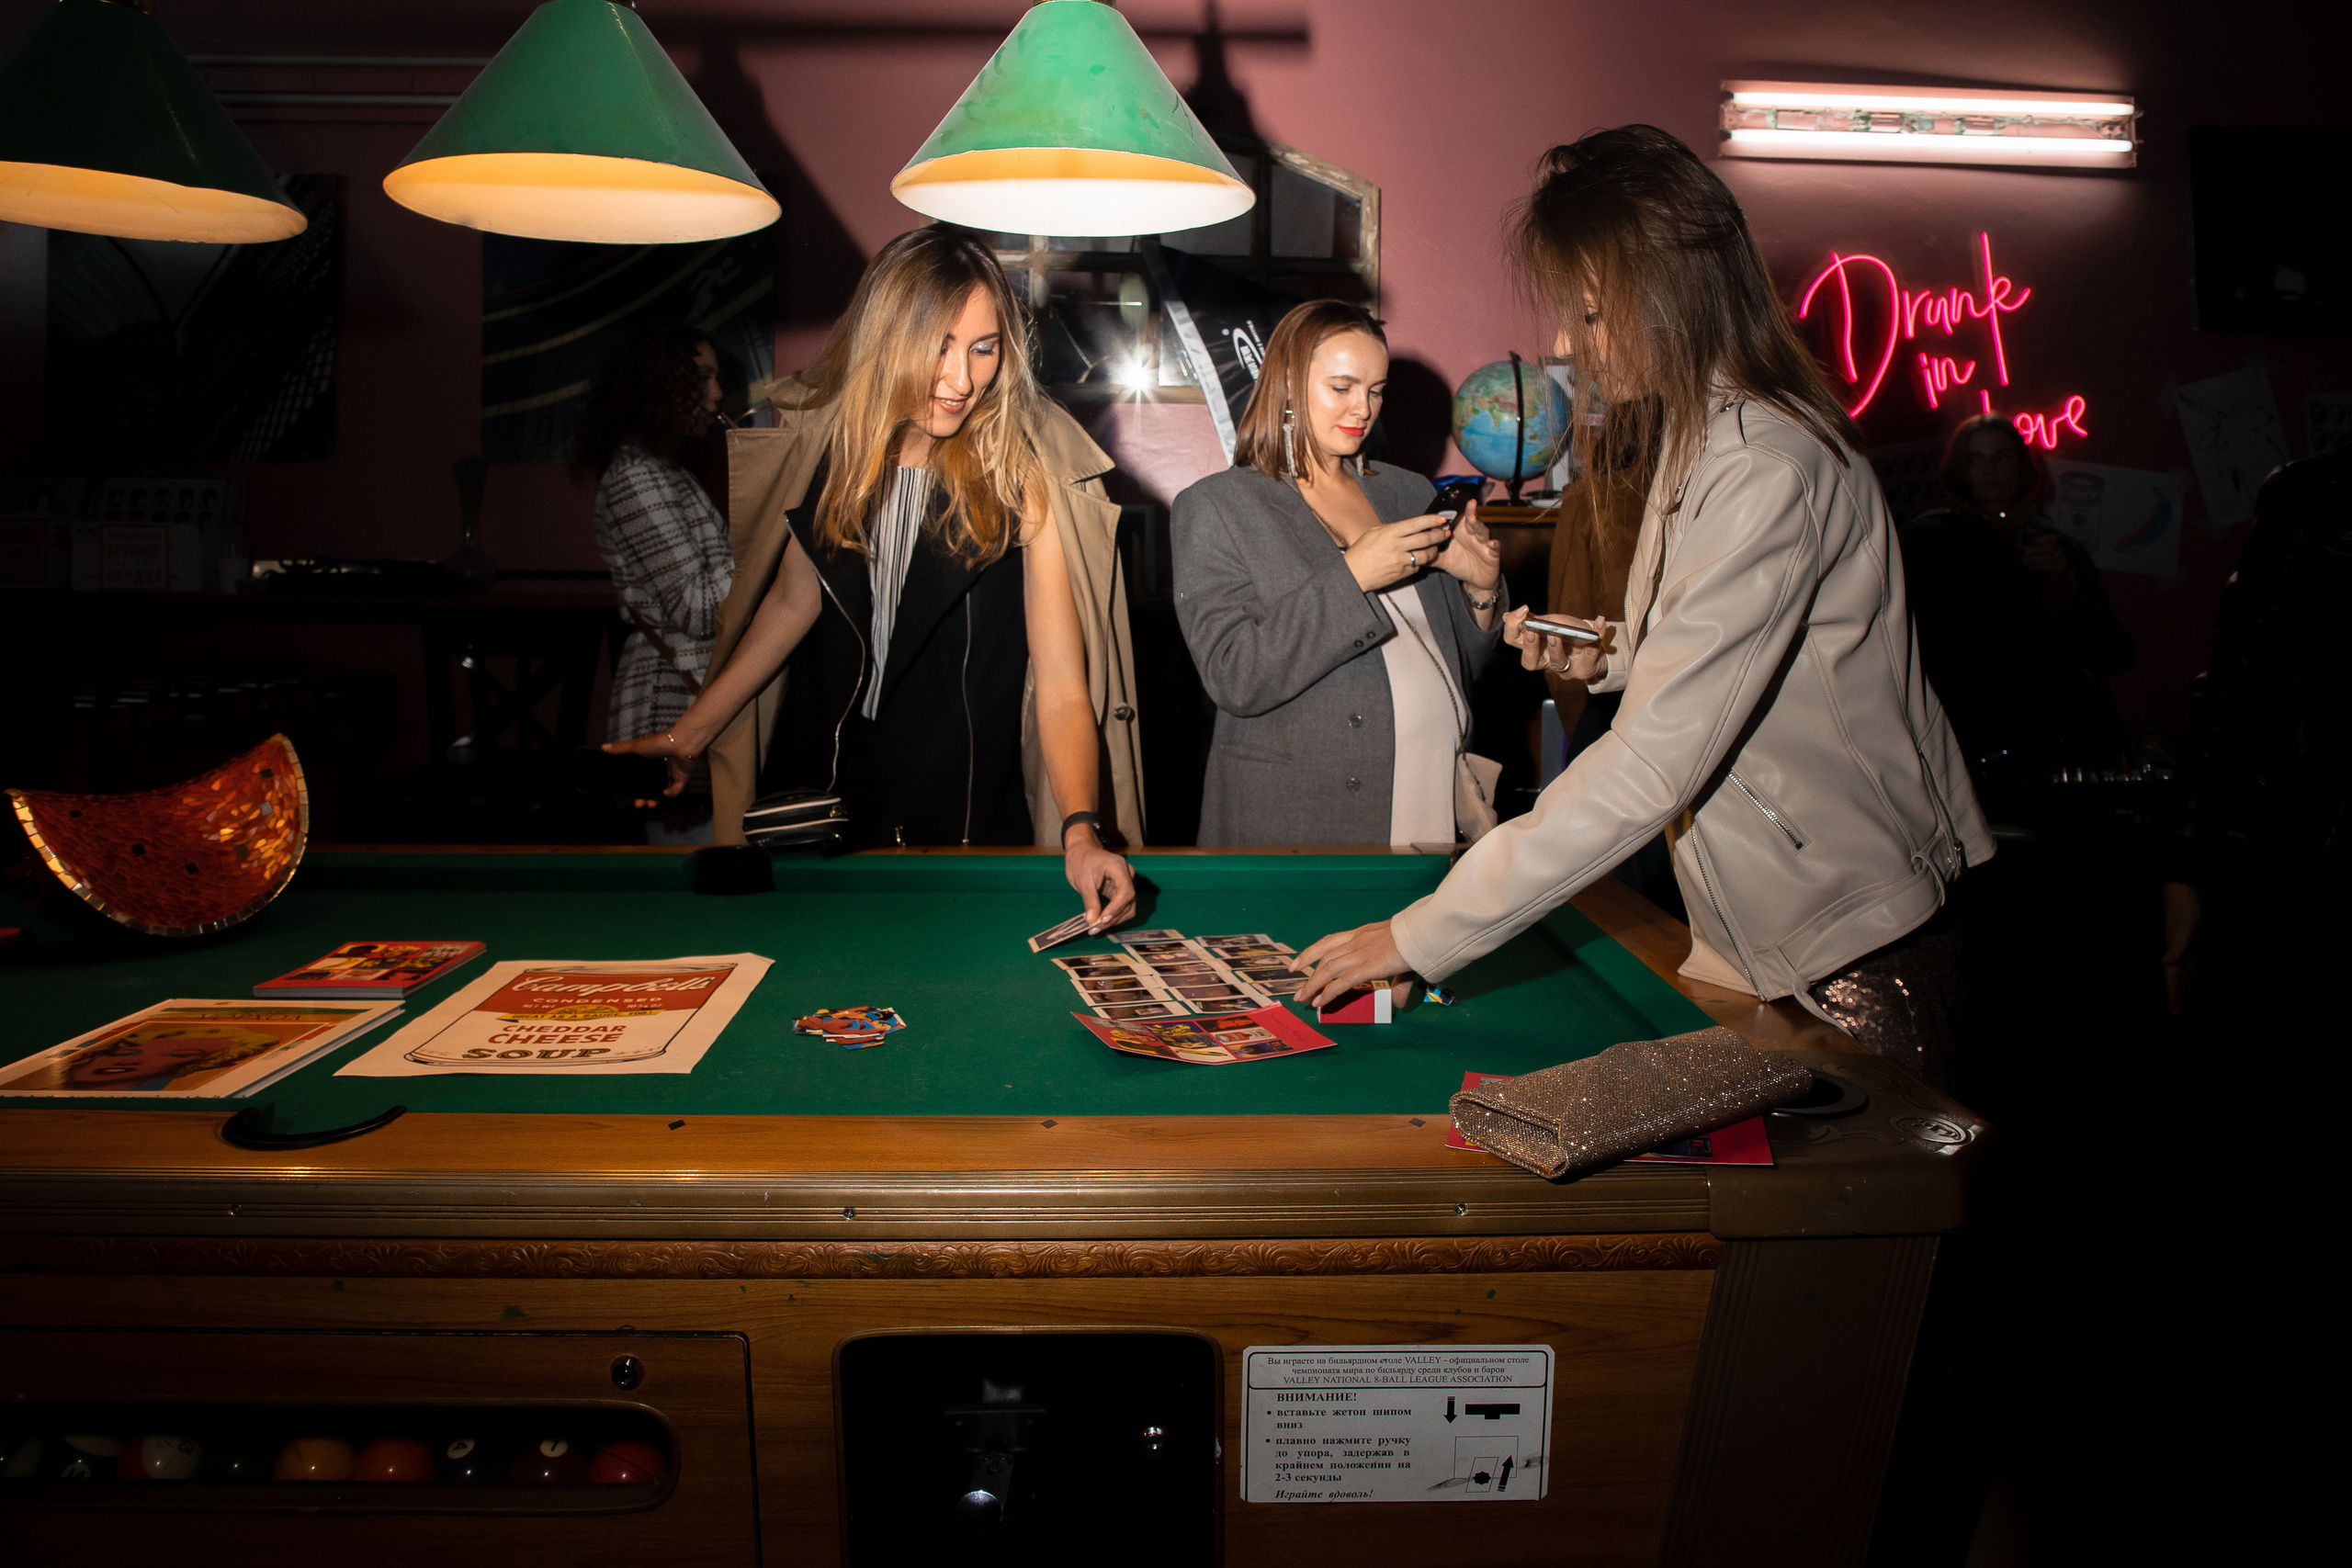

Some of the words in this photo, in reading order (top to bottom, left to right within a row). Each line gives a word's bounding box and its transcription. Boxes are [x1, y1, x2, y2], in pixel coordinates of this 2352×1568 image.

[1799, 231, 2031, 418] Drunk
[1920, 353, 1975, 408] in
[488, 1032, 624, 1044] CHEESE
[462, 1048, 611, 1059] SOUP
[1328, 1357, 1377, 1365] бильярдном
[1449, 1357, 1504, 1365] официальном
[1377, 1367, 1416, 1375] бильярду
[1417, 1367, 1441, 1375] среди
[1442, 1366, 1471, 1374] клубов
[1481, 1366, 1504, 1375] баров
[1322, 1375, 1371, 1383] NATIONAL
[1409, 1374, 1447, 1382] LEAGUE
[1450, 1374, 1512, 1382] ASSOCIATION
[1276, 1393, 1356, 1402] ВНИМАНИЕ!
[550, 1440, 560, 1452] 7
[1377, 1438, 1410, 1446] ручку
[1296, 1450, 1332, 1459] упора,
[1341, 1450, 1394, 1459] задержав
[1275, 1461, 1323, 1471] крайнем
[1274, 1472, 1291, 1481] 2-3
[1295, 1475, 1341, 1483] секунды
[1274, 1490, 1323, 1500] Играйте
[1328, 1490, 1373, 1499] вдоволь!
